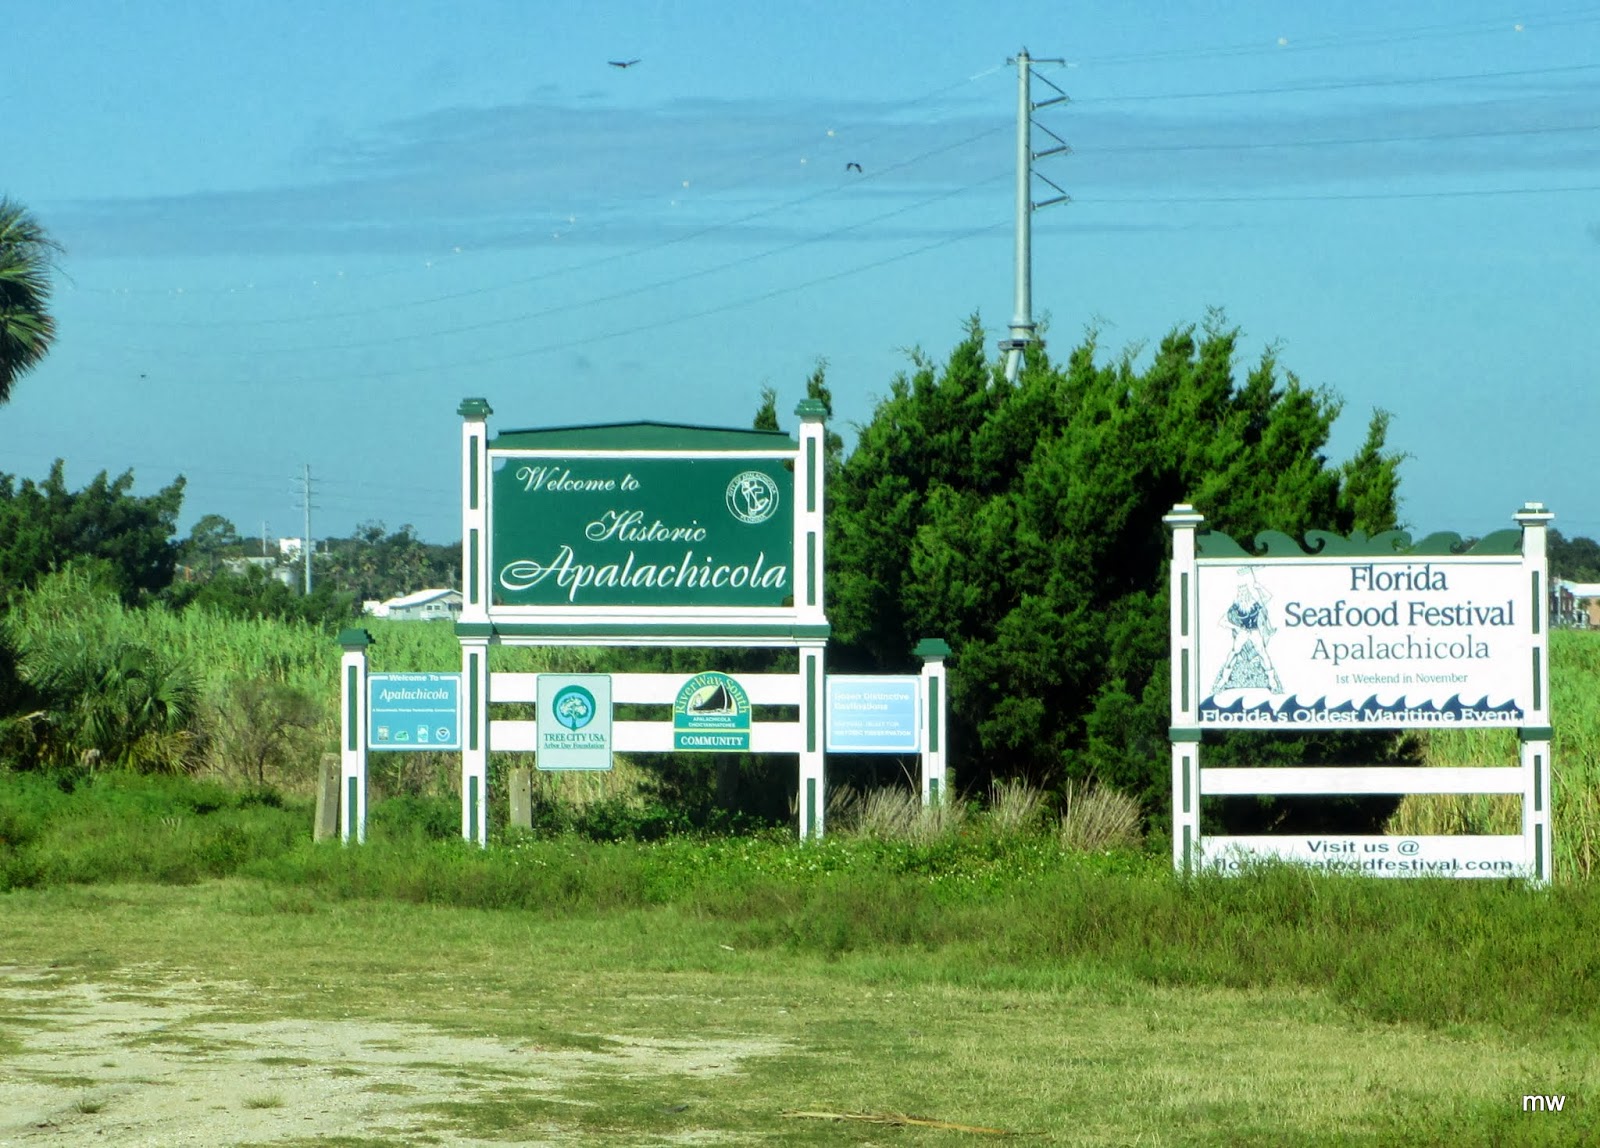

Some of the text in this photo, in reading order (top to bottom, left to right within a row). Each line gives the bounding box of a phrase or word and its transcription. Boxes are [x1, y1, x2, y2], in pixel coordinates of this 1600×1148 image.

[516, 466, 641, 491] Welcome to
[585, 510, 706, 542] Historic
[500, 544, 787, 602] Apalachicola
[1350, 564, 1448, 592] Florida
[1284, 600, 1515, 627] Seafood Festival
[1311, 634, 1490, 665] Apalachicola
[388, 674, 439, 682] Welcome To
[1336, 673, 1468, 684] 1st Weekend in November
[379, 688, 449, 703] Apalachicola
[1201, 708, 1518, 722] Florida's Oldest Maritime Event
[544, 733, 605, 741] TREE CITY USA
[681, 736, 744, 746] COMMUNITY
[1307, 840, 1420, 856] Visit us @
